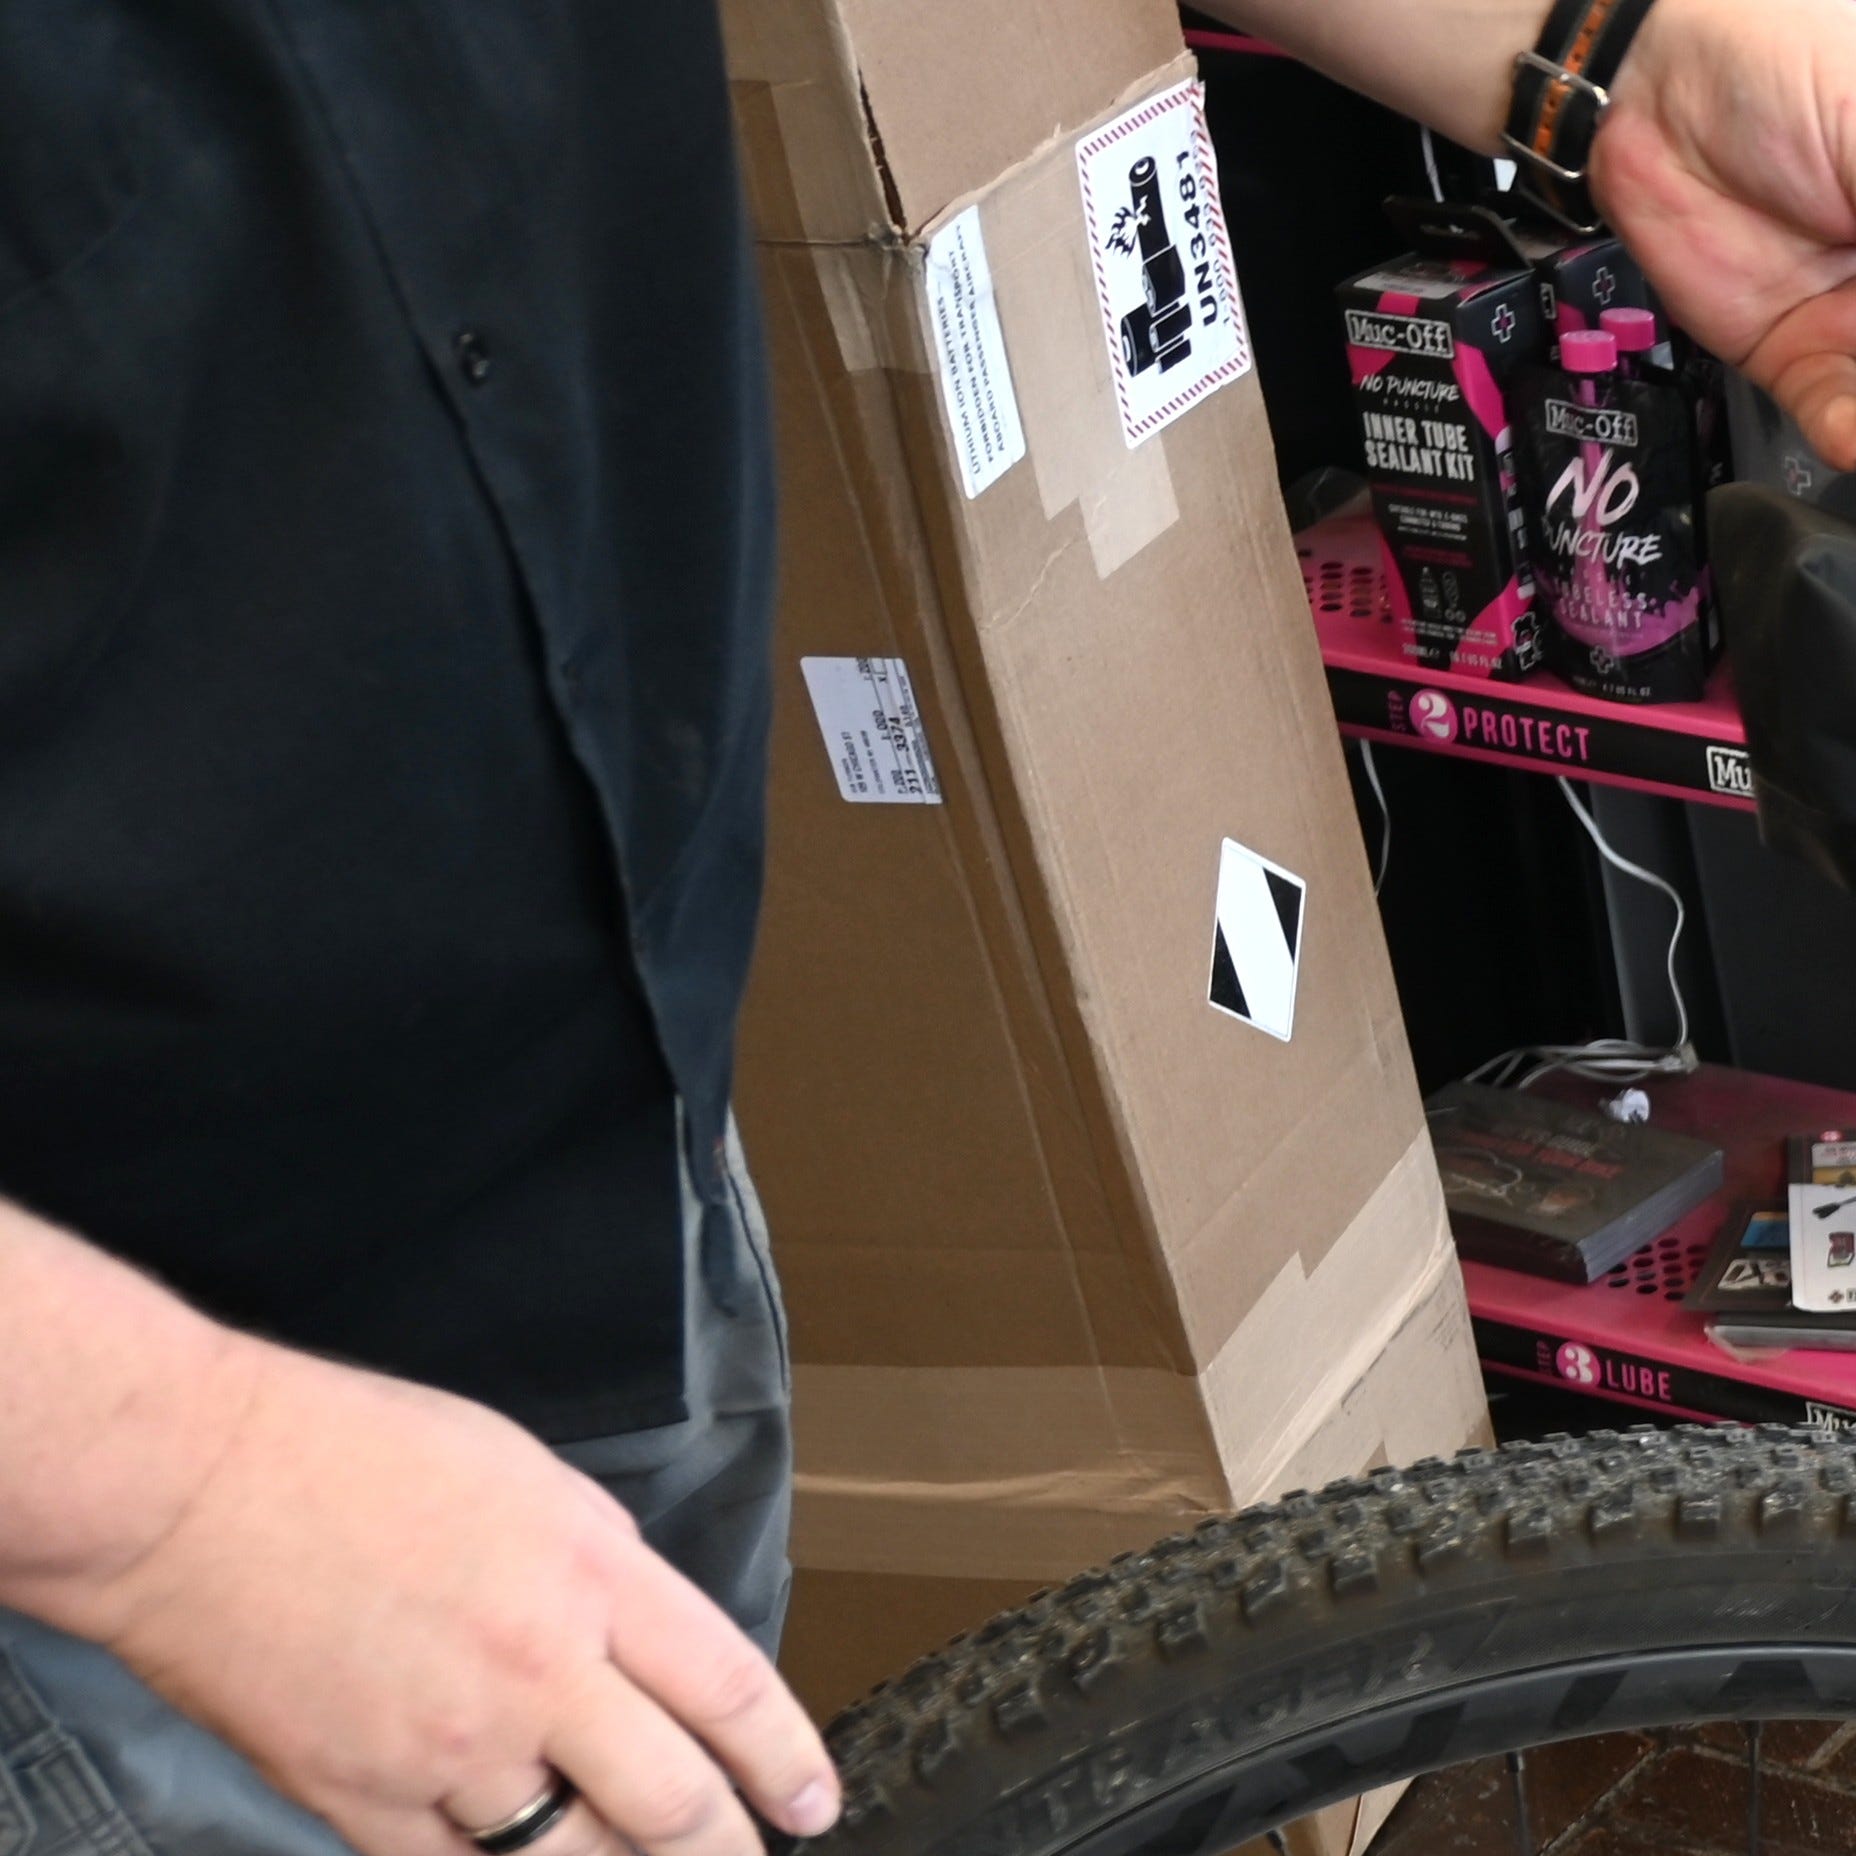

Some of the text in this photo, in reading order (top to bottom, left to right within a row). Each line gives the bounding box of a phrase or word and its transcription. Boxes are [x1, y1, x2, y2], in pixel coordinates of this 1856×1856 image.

[1176, 150, 1219, 327] UN3481
[949, 250, 994, 463] FORBIDDEN FOR TRANSPORT
[968, 302, 990, 388] PASSENGER
[1351, 316, 1449, 353] Muc-Off
[937, 296, 980, 475] LITHIUM ION BATTERIES
[1360, 374, 1460, 402] NO PUNCTURE
[986, 390, 1005, 452] ABOARD
[1362, 411, 1469, 452] INNER TUBE
[1550, 405, 1636, 443] Muc-Off
[1365, 440, 1475, 481] SEALANT KIT
[1546, 450, 1639, 526] NO
[1543, 514, 1664, 567] PUNCTURE
[1417, 697, 1450, 739] 2
[1464, 707, 1591, 760] PROTECT
[1564, 1347, 1593, 1385] 3
[1606, 1363, 1672, 1401] LUBE
